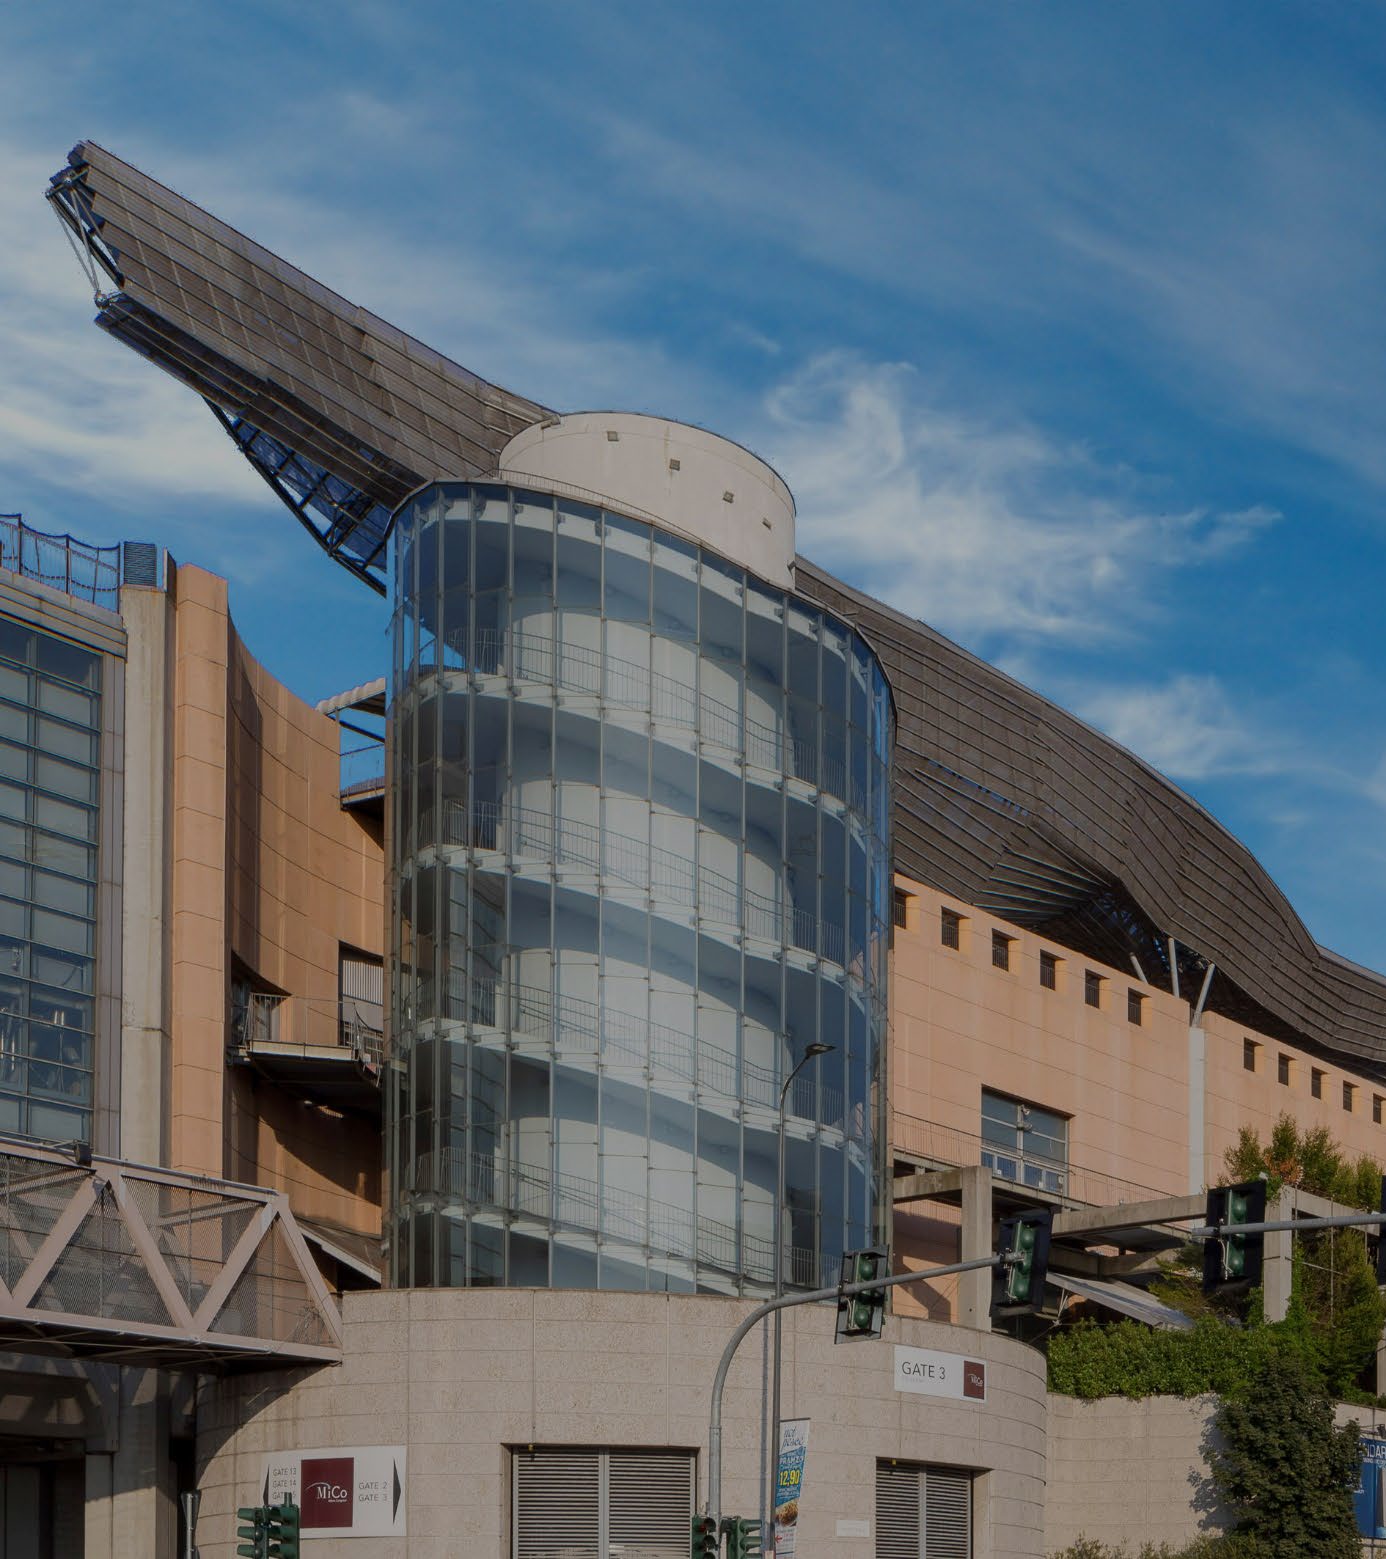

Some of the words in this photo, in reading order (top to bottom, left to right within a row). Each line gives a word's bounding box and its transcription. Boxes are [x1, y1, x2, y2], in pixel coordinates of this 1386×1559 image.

[901, 1361, 935, 1379] GATE
[939, 1366, 946, 1380] 3
[273, 1468, 288, 1476] GATE
[779, 1469, 800, 1486] 12,90
[272, 1480, 288, 1488] GATE
[358, 1481, 379, 1490] GATE
[382, 1481, 388, 1489] 2
[272, 1491, 284, 1499] GAT
[317, 1486, 347, 1499] MiCo
[358, 1493, 379, 1502] GATE
[382, 1493, 388, 1501] 3
